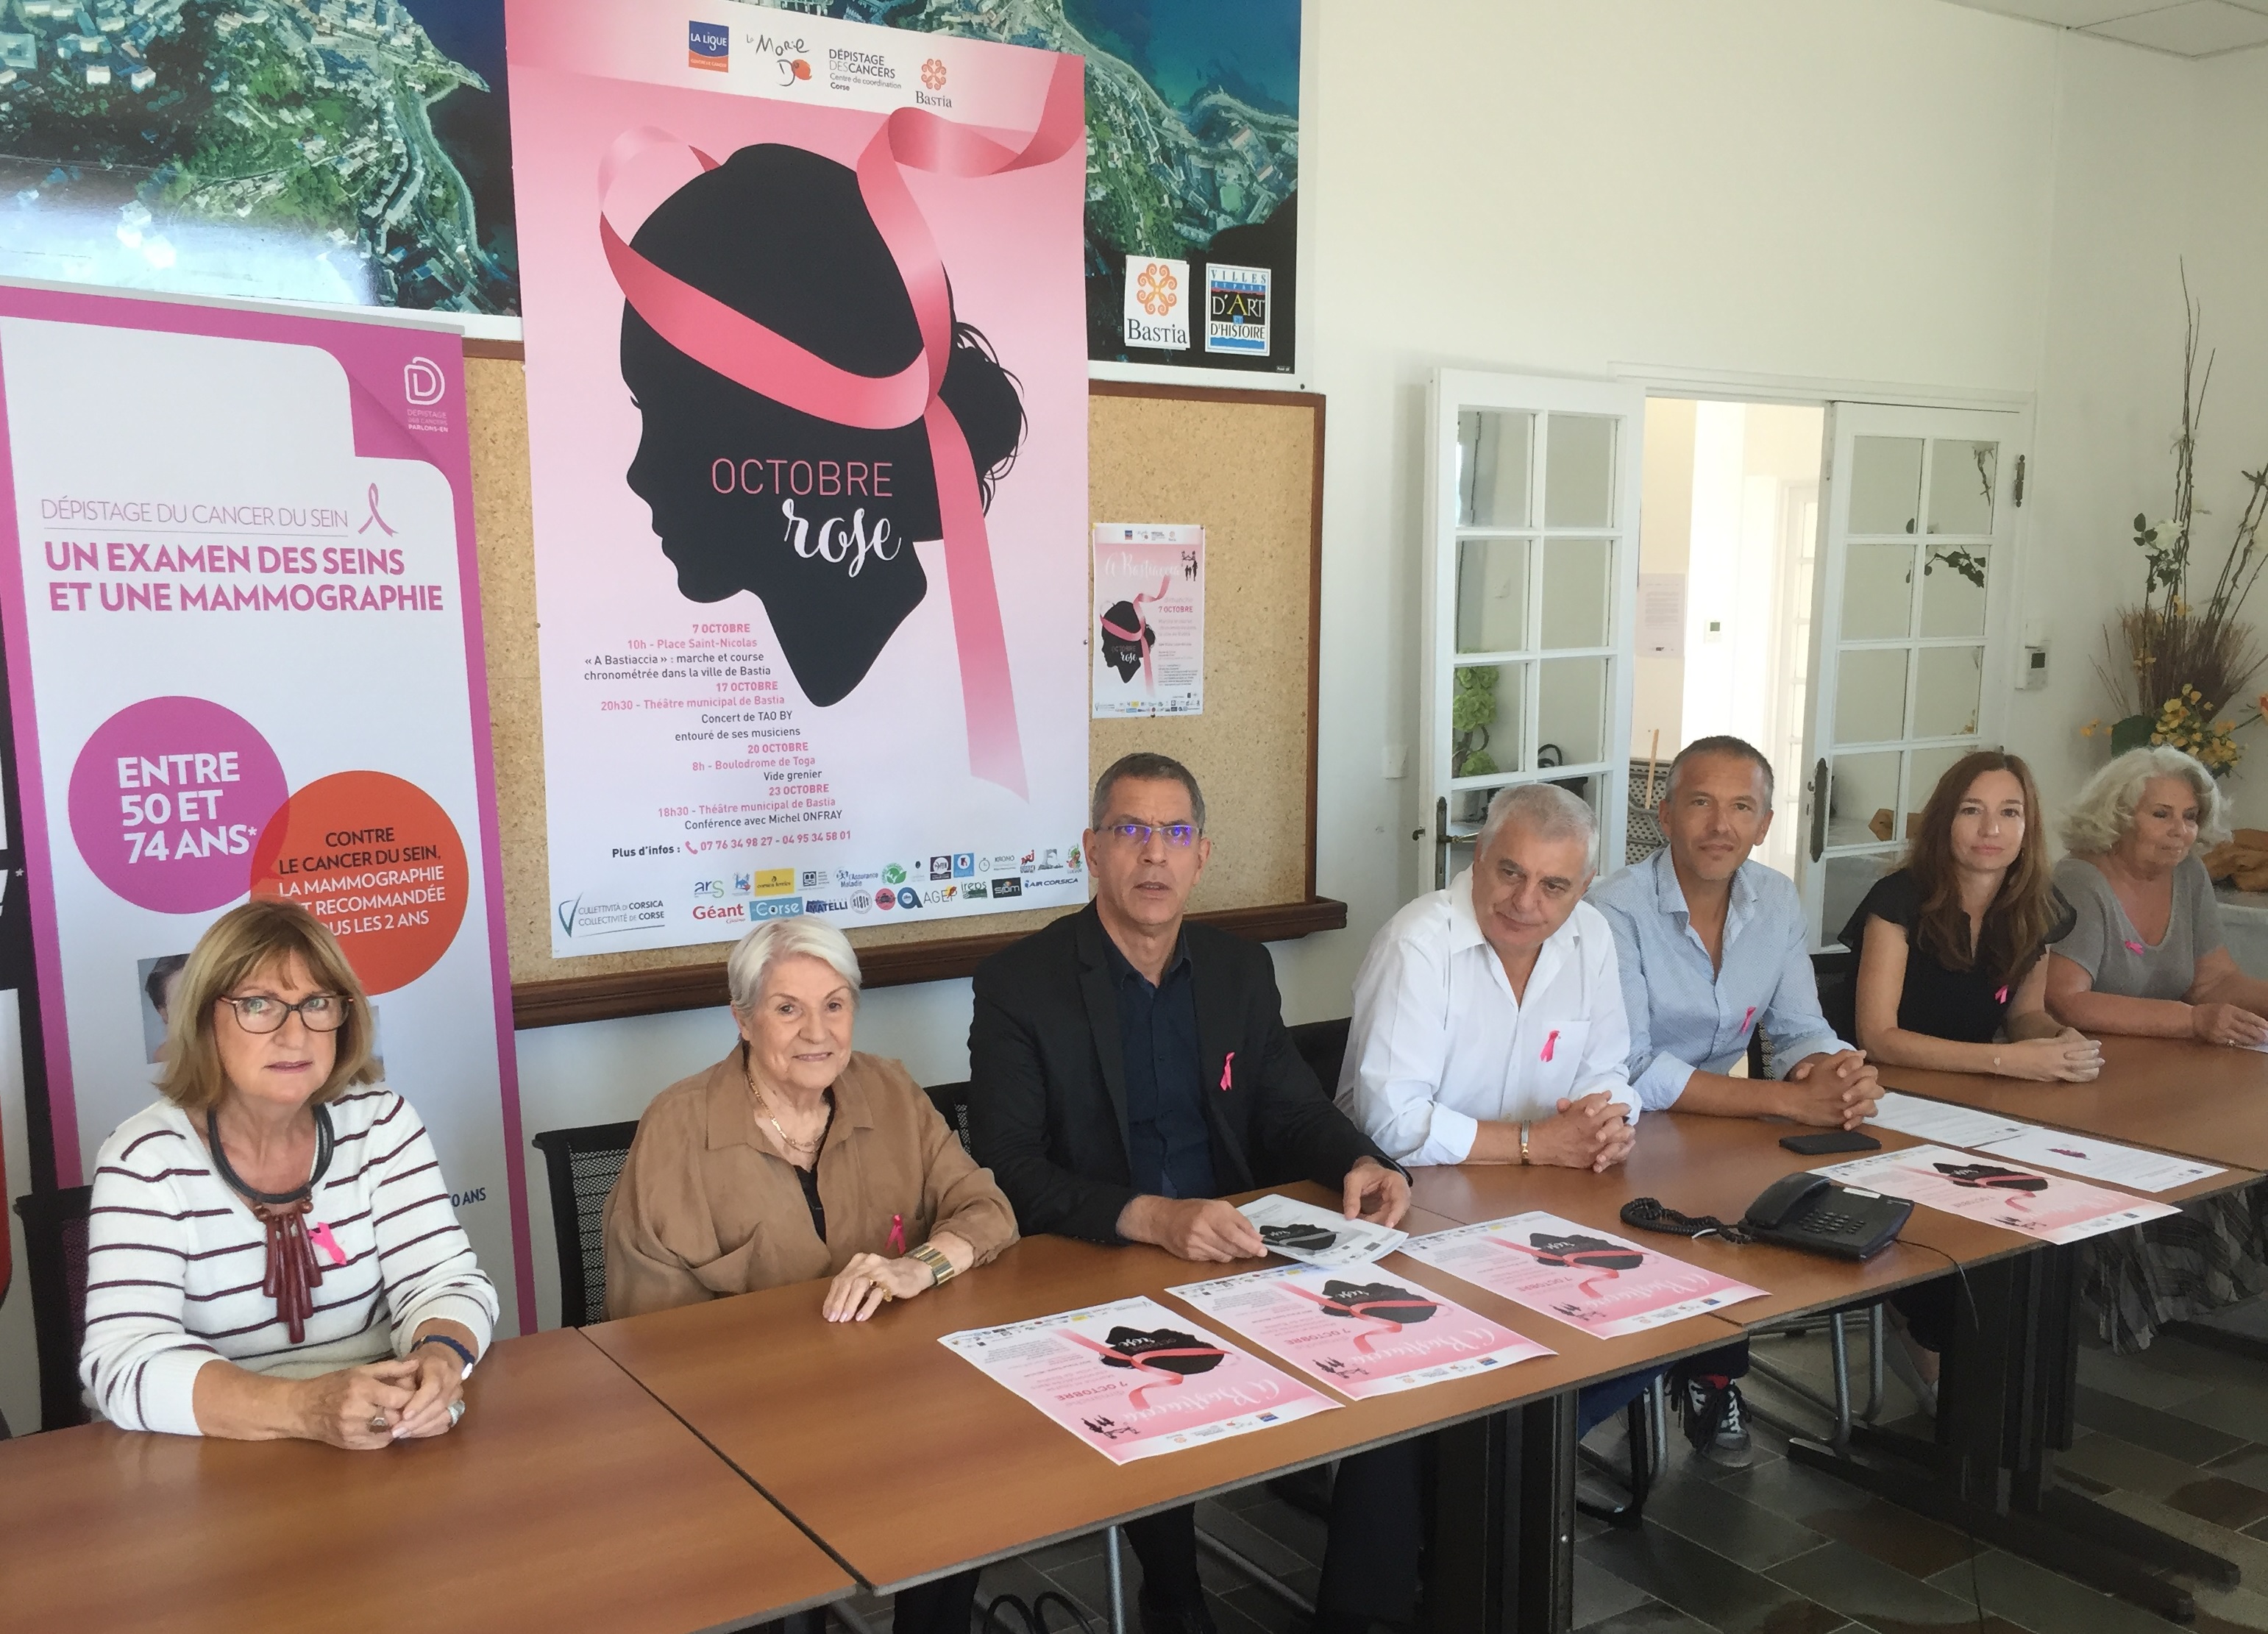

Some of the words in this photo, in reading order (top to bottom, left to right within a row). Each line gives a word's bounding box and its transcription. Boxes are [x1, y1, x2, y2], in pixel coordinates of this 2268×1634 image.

[690, 32, 701, 42] LA
[829, 48, 885, 66] DÉPISTAGE
[830, 73, 851, 82] Centre
[862, 78, 902, 89] coordination
[830, 82, 850, 91] Corse
[915, 90, 953, 108] Bastia
[1211, 269, 1267, 284] VILLES
[1212, 294, 1265, 318] D'ART
[1127, 319, 1187, 344] Bastia
[1211, 323, 1265, 339] D'HISTOIRE
[711, 458, 893, 497] OCTOBRE
[41, 496, 153, 522] DÉPISTAGE
[157, 503, 187, 524] DU
[192, 504, 274, 527] CANCER
[279, 507, 305, 527] DU
[310, 508, 348, 528] SEIN
[781, 498, 902, 578] rose
[45, 541, 99, 572] UN
[107, 543, 250, 573] EXAMEN
[258, 545, 317, 574] DES
[323, 547, 405, 575] SEINS
[49, 581, 92, 611] ET
[100, 582, 171, 611] UNE
[180, 583, 444, 611] MAMMOGRAPHIE
[692, 625, 699, 633] 7
[701, 623, 750, 633] OCTOBRE
[628, 639, 647, 650] 10h
[657, 639, 686, 649] Place
[689, 637, 758, 649] Saint-Nicolas
[605, 654, 658, 666] Bastiaccia
[677, 653, 715, 664] marche
[717, 653, 728, 662] et
[730, 652, 764, 662] course
[584, 667, 659, 681] chronométrée
[662, 668, 686, 678] dans
[689, 667, 699, 678] la
[700, 667, 722, 677] ville
[725, 667, 737, 676] de
[739, 666, 771, 676] Bastia
[716, 683, 728, 692] 17
[730, 681, 778, 692] OCTOBRE
[601, 700, 633, 711] 20h30
[643, 698, 684, 710] Théâtre
[686, 696, 736, 710] municipal
[739, 696, 751, 706] de
[754, 695, 785, 706] Bastia
[701, 712, 740, 724] Concert
[743, 711, 756, 722] de
[758, 711, 777, 721] TAO
[779, 710, 793, 720] BY
[675, 730, 714, 742] entouré
[717, 730, 729, 740] de
[731, 731, 749, 739] ses
[751, 727, 801, 739] musiciens
[747, 745, 760, 754] 20
[762, 742, 808, 753] OCTOBRE
[117, 751, 240, 788] ENTRE
[692, 761, 705, 771] 8h
[715, 758, 776, 770] Boulodrome
[778, 758, 791, 767] de
[792, 756, 816, 768] Toga
[764, 771, 784, 781] Vide
[786, 770, 822, 782] grenier
[769, 786, 781, 796] 23
[783, 784, 830, 795] OCTOBRE
[121, 792, 171, 826] 50
[179, 789, 224, 822] ET
[658, 806, 689, 817] 18h30
[698, 803, 739, 816] Théâtre
[740, 800, 789, 814] municipal
[791, 800, 803, 809] de
[806, 798, 836, 809] Bastia
[685, 817, 742, 831] Conférence
[744, 816, 766, 826] avec
[768, 813, 801, 825] Michel
[803, 810, 843, 822] ONFRAY
[326, 827, 395, 848] CONTRE
[611, 847, 636, 859] Plus
[639, 845, 675, 856] d'infos
[700, 841, 714, 851] 07
[715, 839, 728, 850] 76
[730, 838, 744, 849] 34
[745, 837, 758, 848] 98
[760, 836, 772, 847] 27
[782, 835, 794, 845] 04
[796, 833, 808, 844] 95
[811, 832, 824, 842] 34
[825, 831, 838, 841] 58
[839, 829, 851, 840] 01
[124, 831, 169, 864] 74
[279, 856, 299, 875] LE
[302, 850, 373, 873] CANCER
[376, 848, 400, 867] DU
[279, 878, 302, 897] LA
[304, 865, 444, 895] MAMMOGRAPHIE
[1044, 878, 1078, 887] CORSICA
[316, 884, 446, 915] RECOMMANDÉE
[629, 900, 664, 910] CORSICA
[639, 911, 664, 920] CORSE
[692, 903, 744, 920] Géant
[756, 902, 800, 917] Corse
[354, 915, 382, 933] LES
[385, 914, 394, 930] 2
[397, 909, 430, 928] ANS
[463, 1187, 486, 1205] ANS
[1055, 1384, 1117, 1402] OCTOBRE
